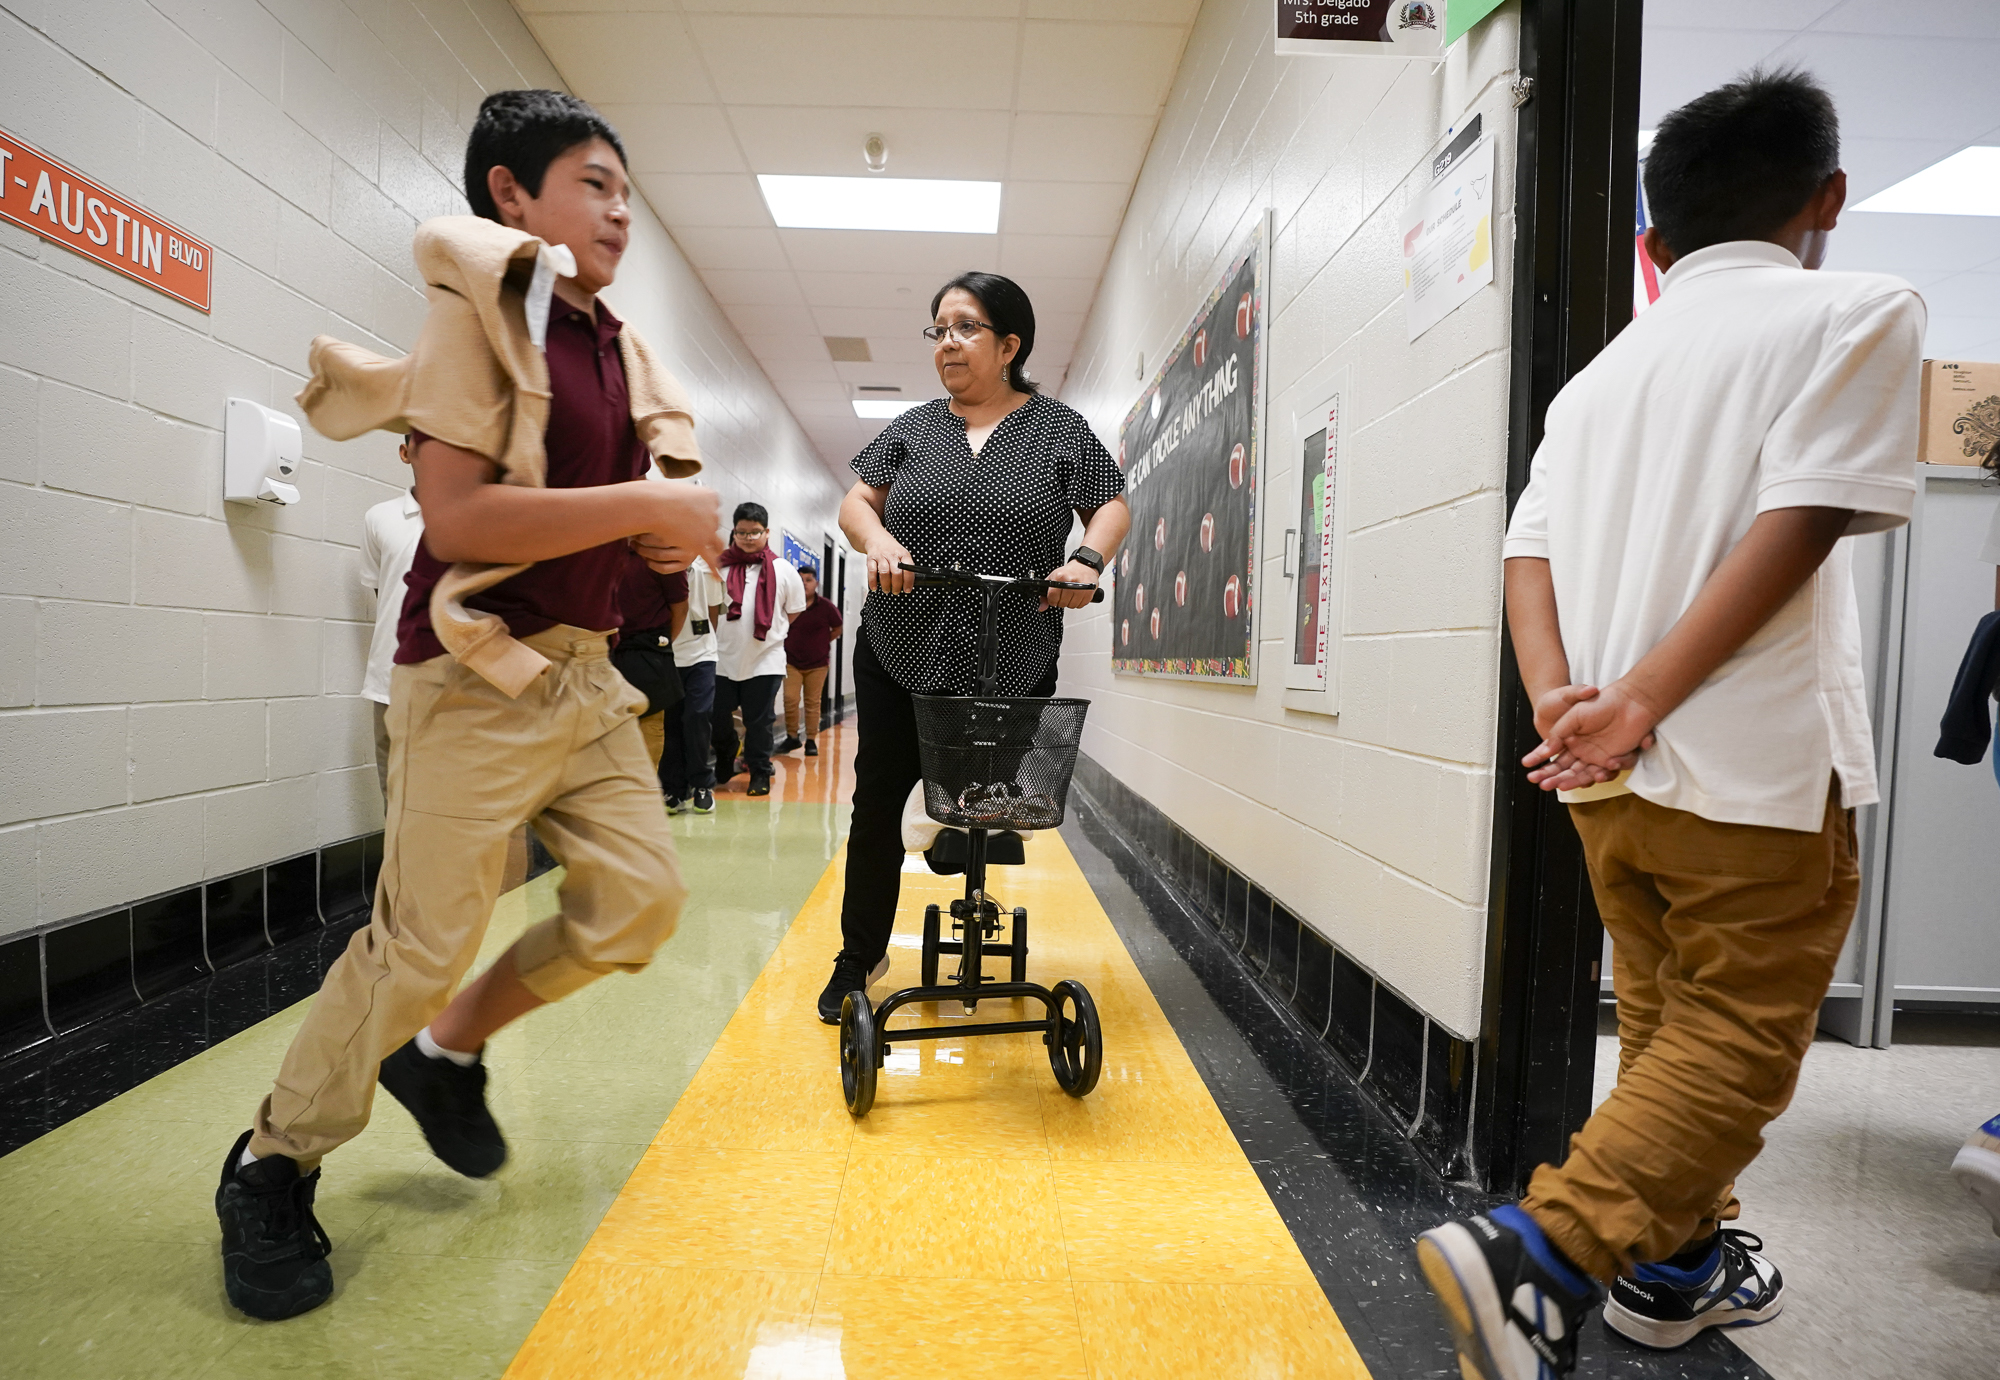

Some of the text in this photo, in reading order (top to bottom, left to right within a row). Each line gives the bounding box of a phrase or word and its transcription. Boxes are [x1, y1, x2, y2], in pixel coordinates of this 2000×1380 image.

[1295, 10, 1359, 27] 5th grade
[1436, 198, 1462, 228] SCHEDULE
[168, 235, 203, 271] BLVD
[1137, 448, 1151, 486] CAN
[1152, 415, 1181, 469] TACKLE
[1182, 352, 1238, 440] ANYTHING
[1317, 409, 1336, 679] FIRE EXTINGUISHER
[1617, 1274, 1655, 1303] Reebok
